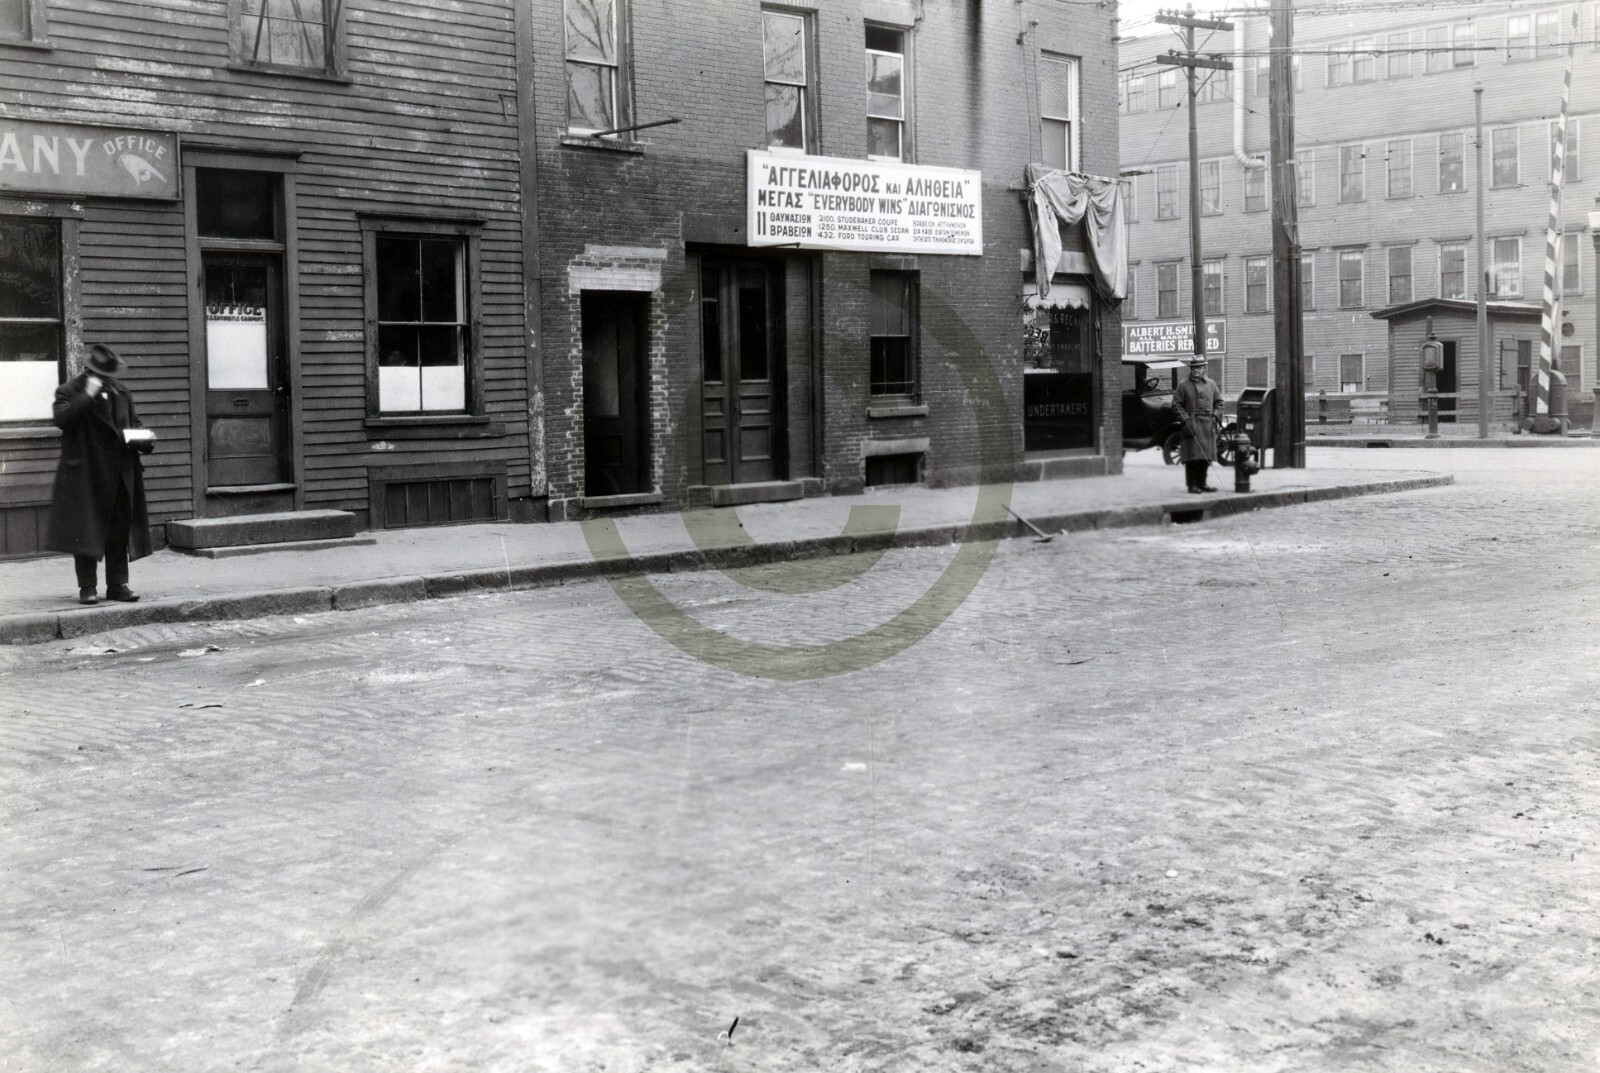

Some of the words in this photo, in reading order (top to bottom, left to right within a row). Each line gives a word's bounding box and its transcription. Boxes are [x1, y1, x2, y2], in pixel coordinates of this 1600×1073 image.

[102, 135, 166, 160] OFFICE
[886, 182, 901, 195] ΚΑΙ
[758, 189, 803, 208] ΜΕΓΑΣ
[757, 211, 766, 236] 11
[837, 216, 876, 225] STUDEBAKER
[877, 218, 898, 226] COUPE
[770, 225, 812, 237] ΒΡΑΒΕΙΩΝ
[838, 224, 868, 232] MAXWELL
[838, 232, 855, 240] FORD
[857, 233, 884, 241] TOURING
[208, 303, 262, 316] OFFICE
[1130, 326, 1164, 337] ALBERT
[1175, 325, 1193, 335] SMI
[1130, 340, 1176, 352] BATTERIES
[1177, 338, 1219, 351] REPED
[1027, 402, 1088, 417] UNDERTAKERS
